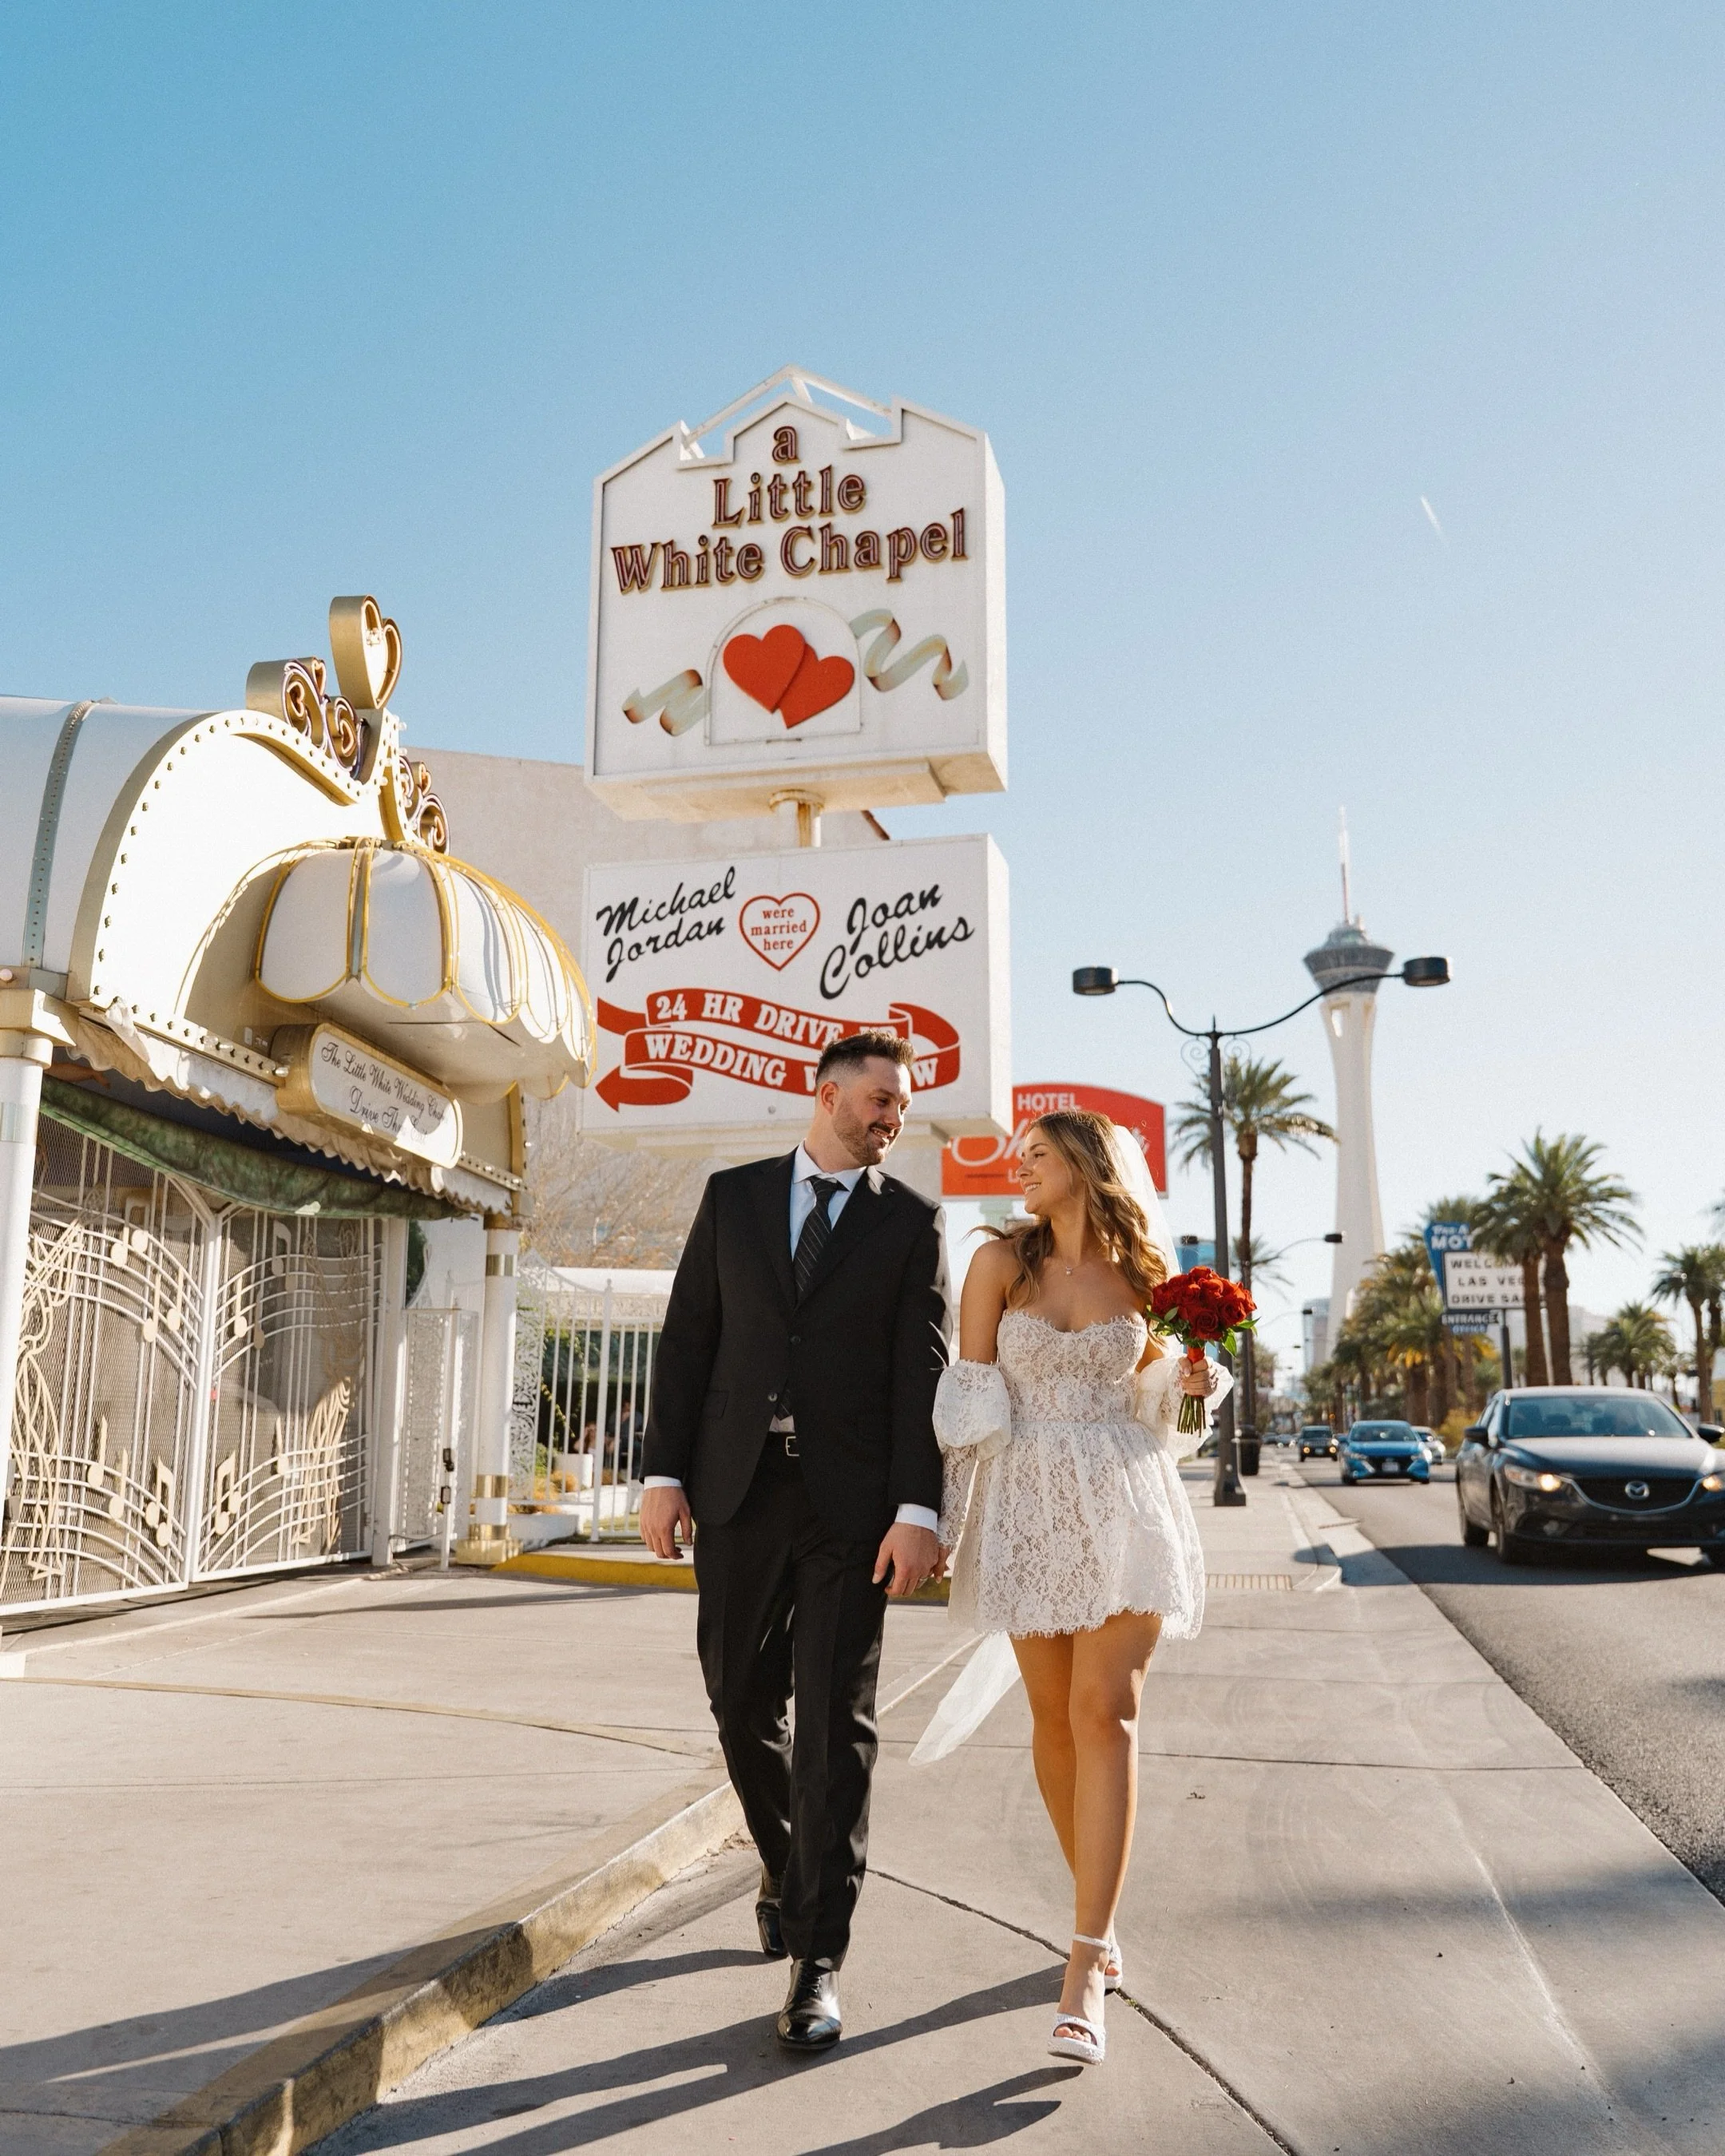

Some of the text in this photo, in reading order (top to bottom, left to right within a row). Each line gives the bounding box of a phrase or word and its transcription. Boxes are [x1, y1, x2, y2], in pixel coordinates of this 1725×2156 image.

[772, 425, 800, 464] a
[711, 464, 866, 530] Little
[611, 507, 970, 595] White Chapel
[596, 866, 736, 937] Michael
[751, 919, 807, 937] married
[762, 906, 795, 920] were
[846, 883, 942, 955] Joan
[605, 916, 726, 983] Jordan
[763, 937, 794, 952] here
[819, 916, 975, 1000] Collins
[656, 994, 687, 1021] 24
[702, 992, 744, 1024] HR
[753, 1004, 843, 1048] DRIVE
[321, 1042, 341, 1068] The
[343, 1051, 366, 1081] Little
[370, 1064, 391, 1095] White
[394, 1078, 425, 1118] Wedding
[644, 1033, 787, 1088] WEDDING
[349, 1085, 379, 1124] Drive
[1017, 1092, 1082, 1111] HOTEL
[1452, 1294, 1494, 1304] DRIVE
[1458, 1276, 1486, 1286] LAS
